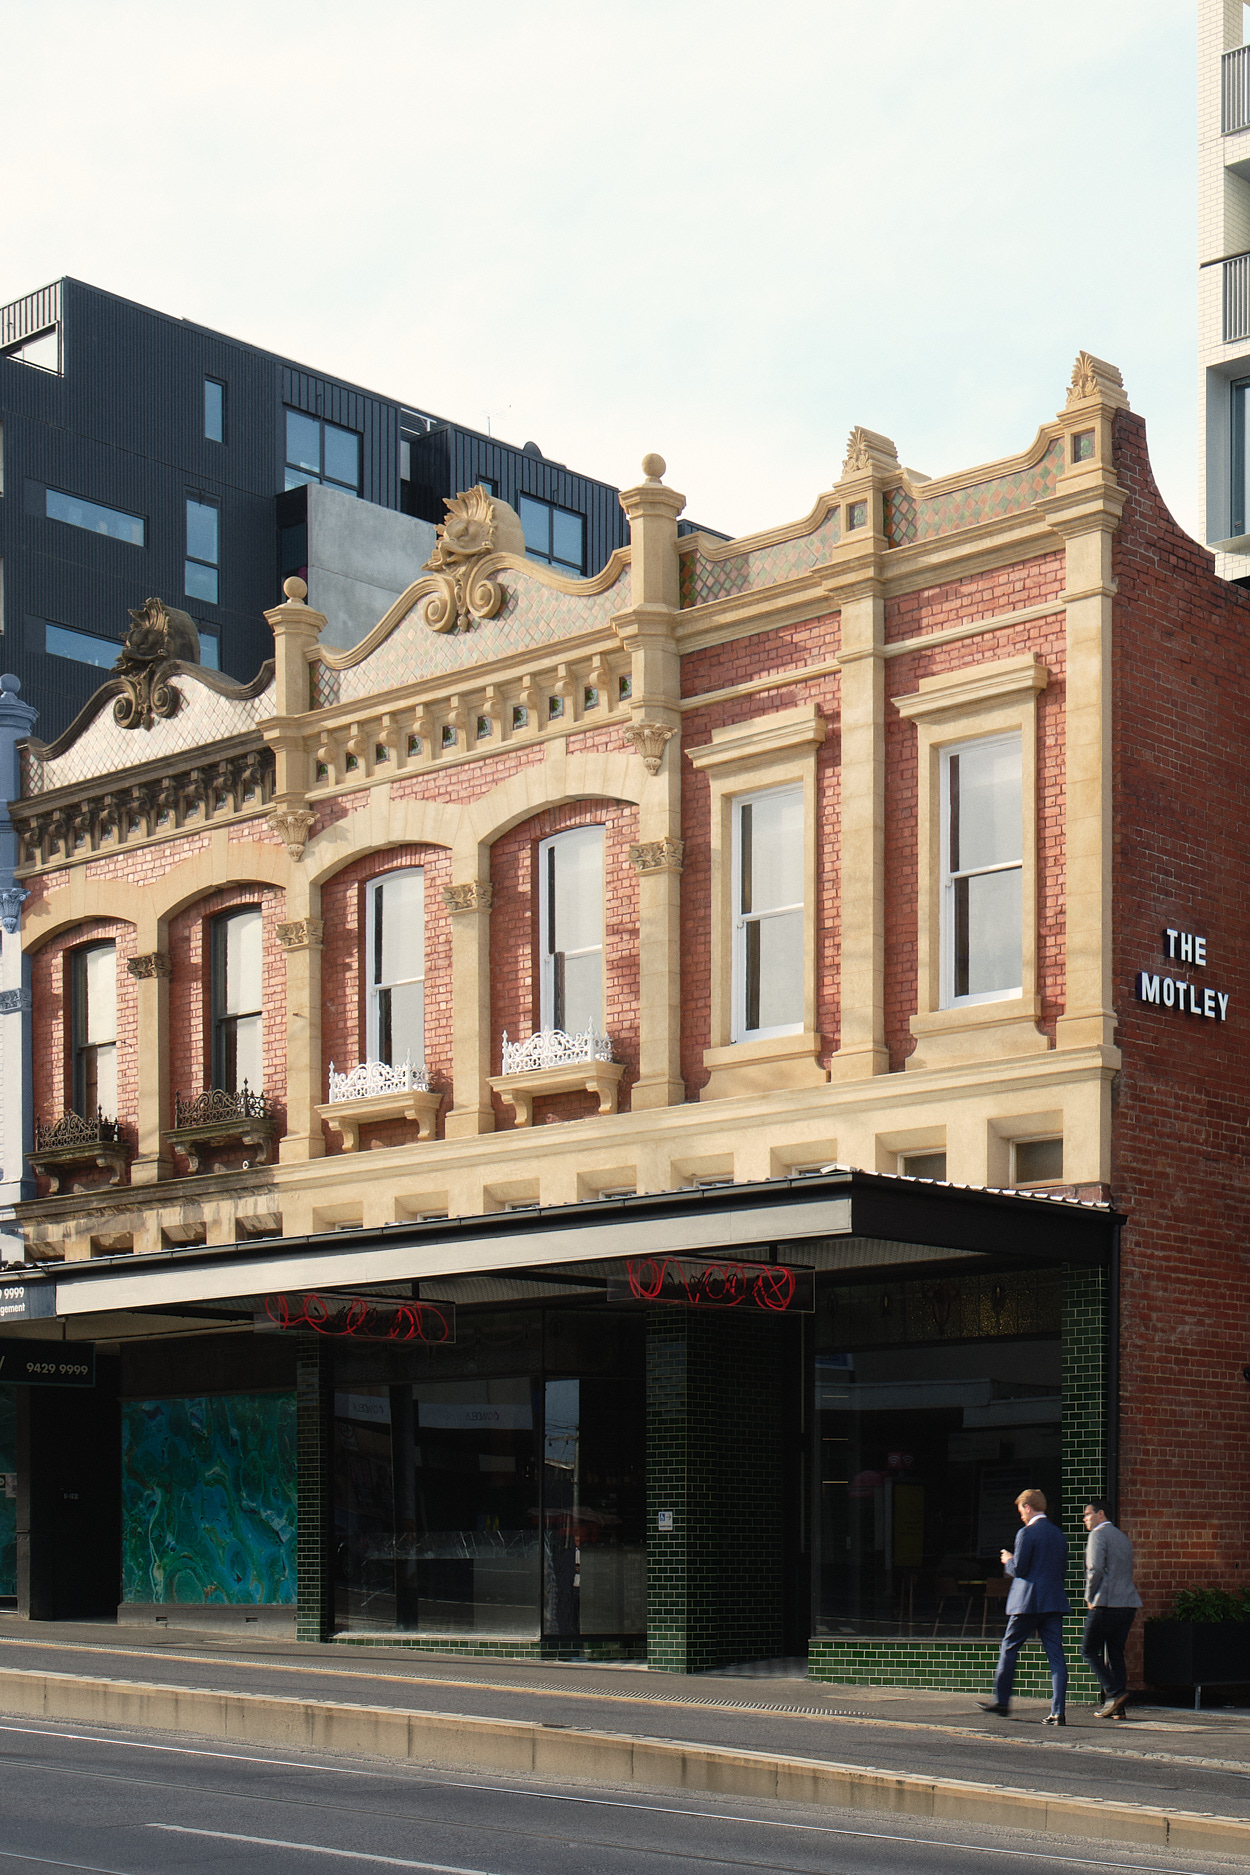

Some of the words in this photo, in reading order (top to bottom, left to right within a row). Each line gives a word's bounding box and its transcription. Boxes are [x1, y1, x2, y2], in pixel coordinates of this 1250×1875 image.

[1166, 928, 1206, 966] THE
[1141, 971, 1229, 1021] MOTLEY
[4, 1287, 24, 1299] 9999
[26, 1362, 56, 1374] 9429
[60, 1364, 88, 1375] 9999
